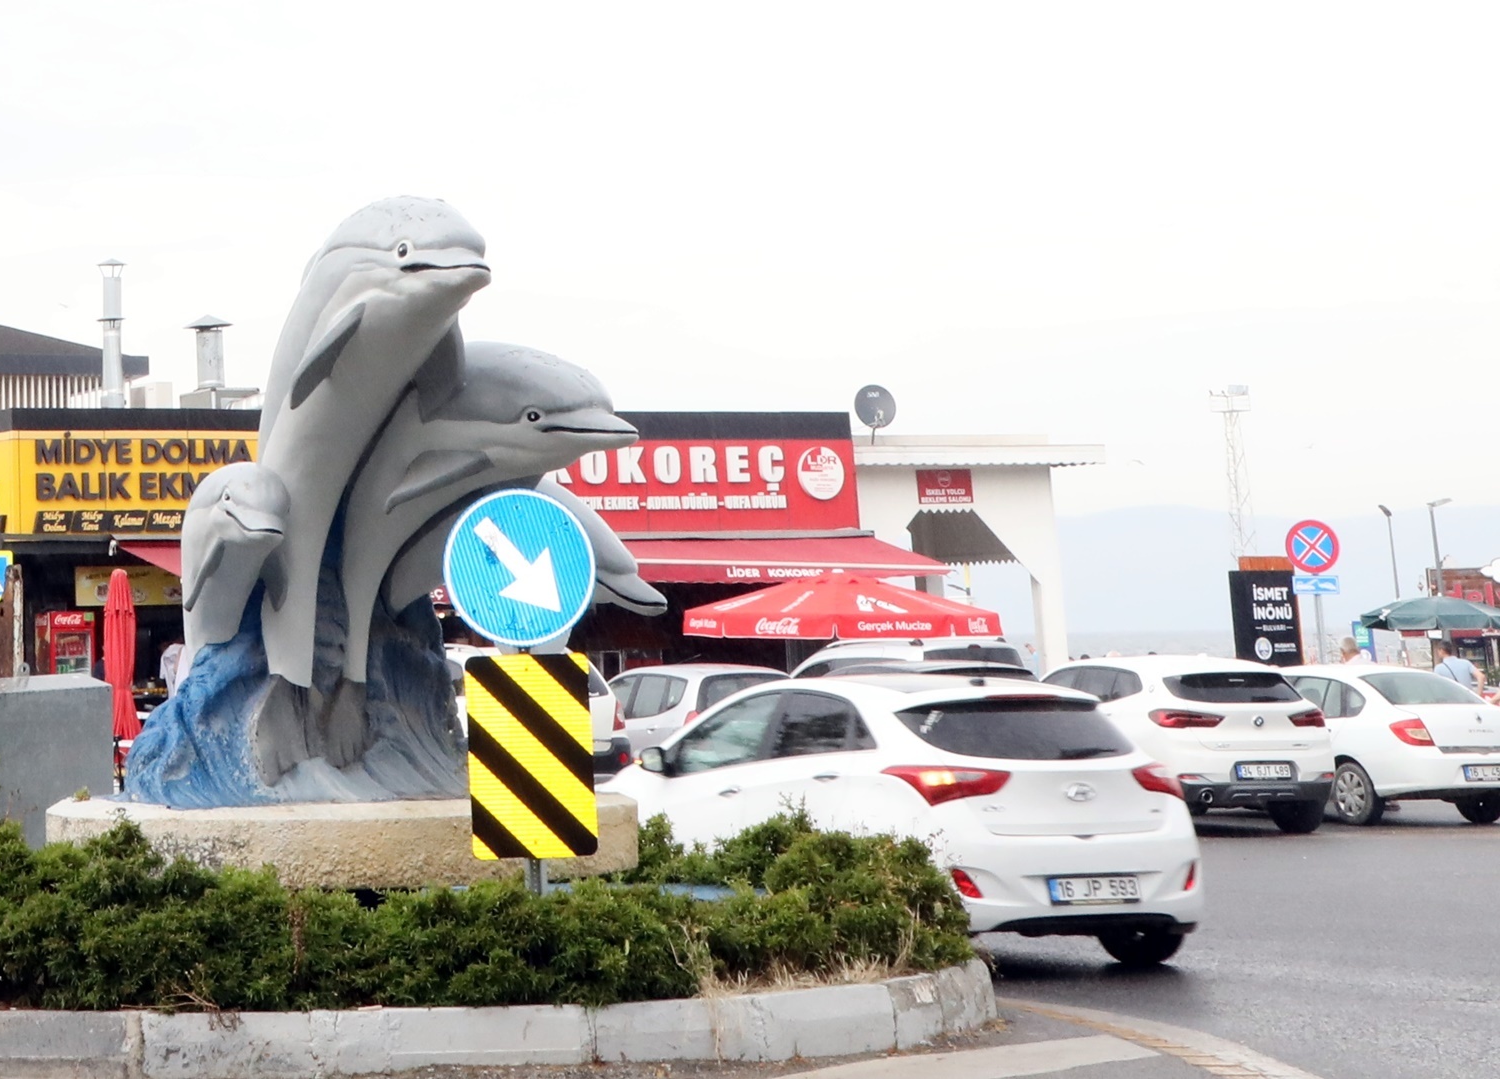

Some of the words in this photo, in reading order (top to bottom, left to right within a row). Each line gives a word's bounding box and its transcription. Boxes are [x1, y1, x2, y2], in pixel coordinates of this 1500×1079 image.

[35, 431, 133, 466] MİDYE
[141, 438, 253, 466] DOLMA
[36, 472, 132, 502] BALIK
[139, 472, 210, 502] EKM
[603, 496, 640, 510] EKMEK
[646, 496, 681, 510] ADANA
[681, 492, 718, 510] DÜRÜM
[724, 495, 751, 509] URFA
[751, 491, 787, 509] DÜRÜM
[43, 522, 67, 532] Dolma
[113, 513, 145, 527] Kalamar
[152, 513, 182, 528] Mezgit
[727, 566, 761, 578] LİDER
[1252, 584, 1288, 601] İSMET
[1252, 603, 1293, 620] İNÖNÜ
[857, 621, 894, 633] Gerçek
[896, 620, 932, 631] Mucize
[1242, 766, 1252, 777] 34
[1256, 765, 1272, 777] GJT
[1274, 765, 1289, 777] 489
[1469, 767, 1480, 778] 16
[1481, 767, 1489, 777] L
[1058, 880, 1076, 898] 16
[1083, 878, 1103, 898] JP
[1108, 878, 1138, 897] 593
